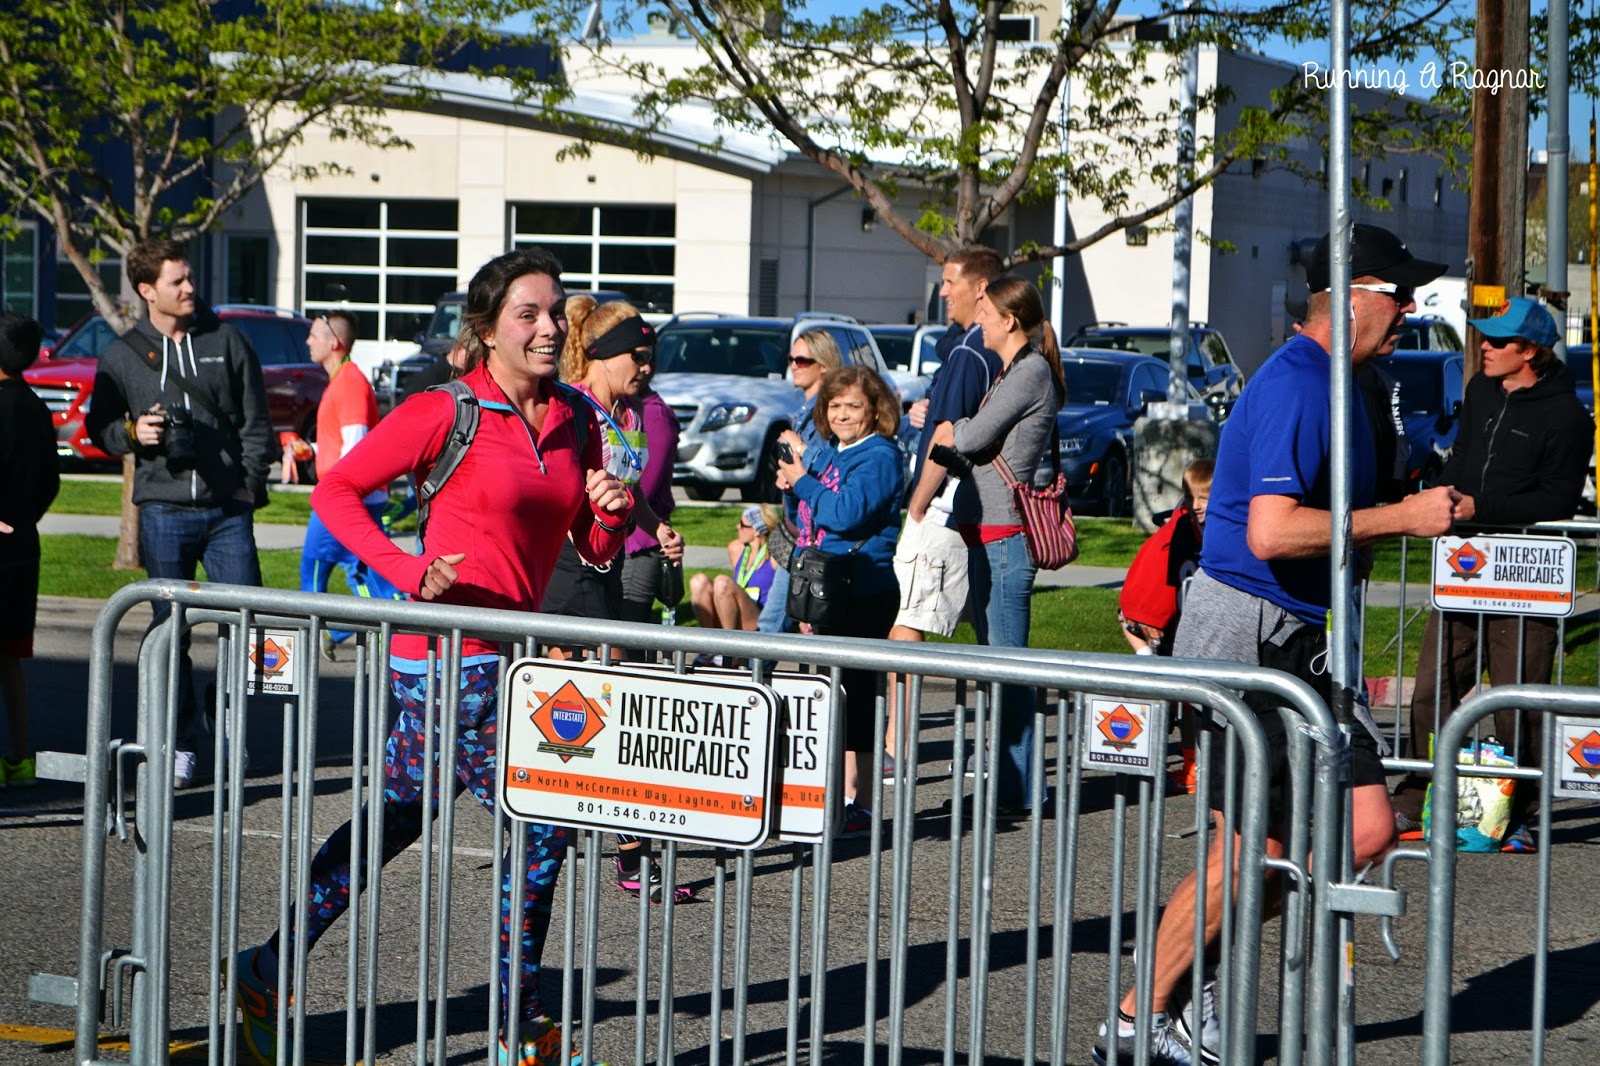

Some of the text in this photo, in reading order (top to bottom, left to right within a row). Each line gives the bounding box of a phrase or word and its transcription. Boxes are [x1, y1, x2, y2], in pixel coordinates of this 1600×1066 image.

[1495, 545, 1564, 566] INTERSTATE
[1494, 564, 1564, 585] BARRICADES
[552, 710, 584, 724] INTERSTATE
[620, 692, 752, 741] INTERSTATE
[618, 731, 749, 780] BARRICADES
[1091, 753, 1147, 766] 801.546.0220
[511, 772, 531, 784] 88
[538, 776, 569, 789] North
[576, 781, 638, 798] McCormick
[578, 801, 687, 826] 801.546.0220
